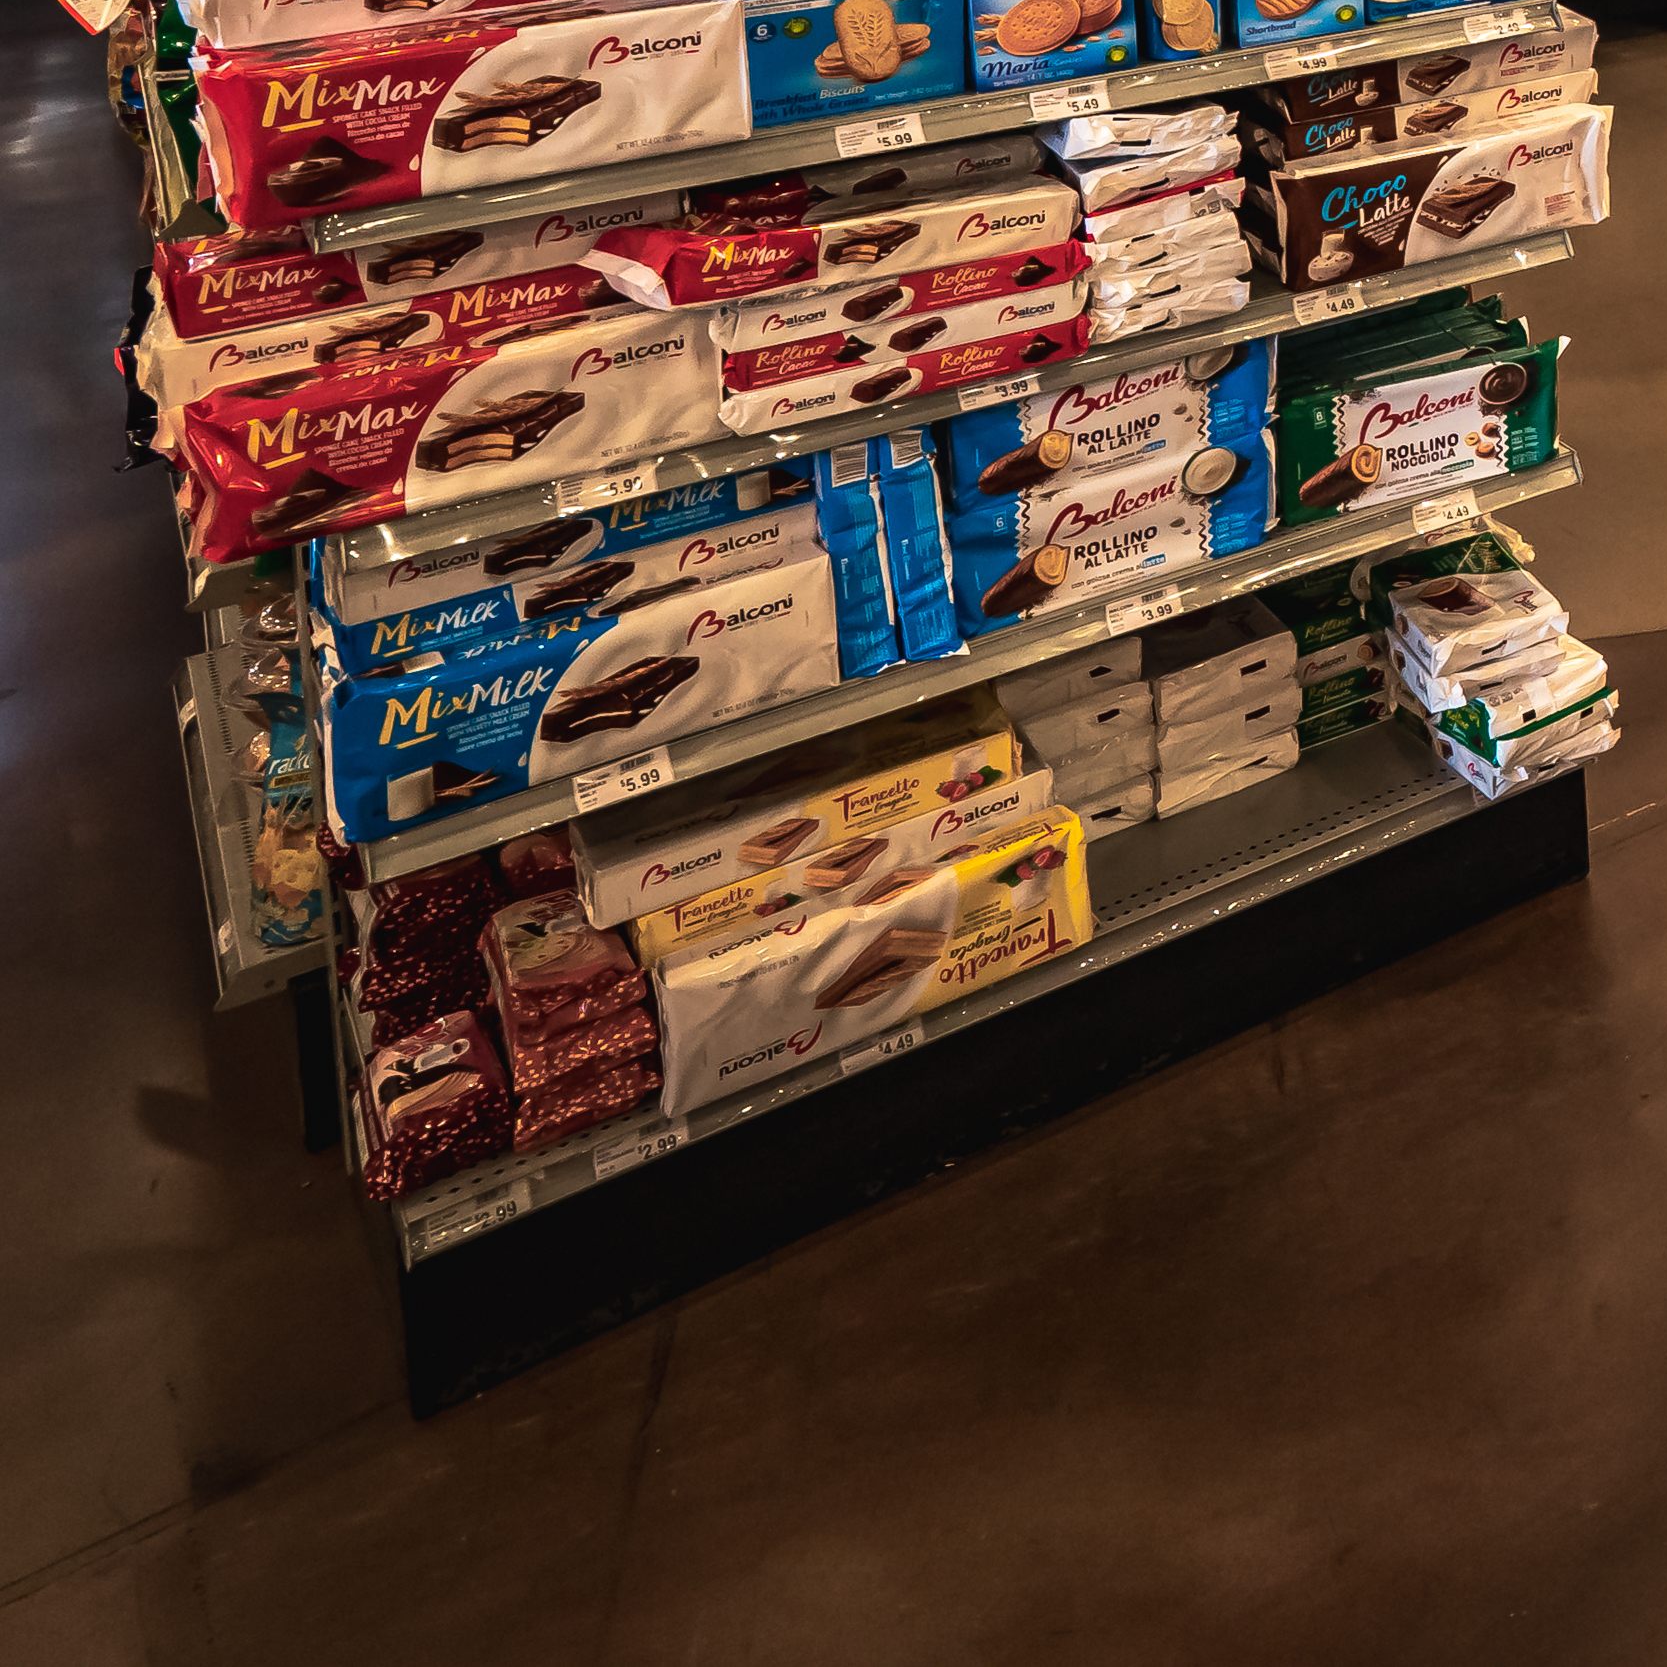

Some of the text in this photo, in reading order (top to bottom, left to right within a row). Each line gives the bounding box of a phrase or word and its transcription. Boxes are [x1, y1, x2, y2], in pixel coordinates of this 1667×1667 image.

[1246, 21, 1297, 36] Shortbread
[588, 30, 702, 71] Balconi
[1500, 40, 1565, 69] Balconi
[261, 73, 447, 128] MixMax
[819, 84, 865, 100] Biscuits
[1067, 99, 1099, 112] $5.49
[1497, 86, 1562, 115] Balconi
[877, 133, 912, 148] $5.99
[1326, 128, 1356, 150] Latte
[1507, 140, 1574, 172] Balconi
[1321, 174, 1407, 222] Choco
[1359, 193, 1412, 227] Latte
[534, 206, 645, 248] Balconi
[957, 210, 1046, 243] Balconi
[701, 245, 794, 273] MixMax
[200, 266, 322, 306] MixMax
[932, 266, 999, 289] Rollino
[953, 282, 989, 296] Cacao
[451, 282, 572, 326] MixMax
[998, 301, 1056, 325] Balconi
[1326, 298, 1354, 313] $4.49
[762, 309, 827, 334] Balconi
[209, 337, 309, 373] Balconi
[571, 334, 685, 381] Balconi
[756, 343, 828, 367] Rollino
[779, 360, 817, 375] Cacao
[940, 345, 1005, 370] Rollino
[961, 360, 997, 375] Cacao
[995, 380, 1028, 397] $3.99
[1048, 365, 1180, 431] Balconi
[771, 392, 836, 417] Balconi
[1360, 388, 1475, 444] Balconi
[248, 400, 430, 464] MixMax
[1077, 413, 1161, 447] ROLLINO
[1087, 428, 1152, 455] AL LATTE
[1385, 433, 1460, 463] ROLLINO
[1391, 447, 1456, 472] NOCCIOLA
[1045, 477, 1176, 545] Balconi
[1442, 504, 1470, 520] $4.49
[679, 524, 780, 571] Balconi
[1075, 525, 1158, 560] ROLLINO
[1084, 542, 1149, 570] AL LATTE
[388, 547, 481, 588] Balconi
[687, 592, 794, 646] Balconi
[1141, 602, 1173, 621] $3.99
[371, 601, 498, 654] MixMilk
[379, 664, 555, 746] MixMilk
[620, 768, 661, 793] $5.99
[833, 775, 921, 820] Trancetto
[929, 790, 1021, 841] Balconi
[640, 849, 723, 890] Balconi
[665, 885, 754, 931] Trancetto
[718, 1021, 824, 1081] Balconi
[877, 1031, 914, 1054] $4.49
